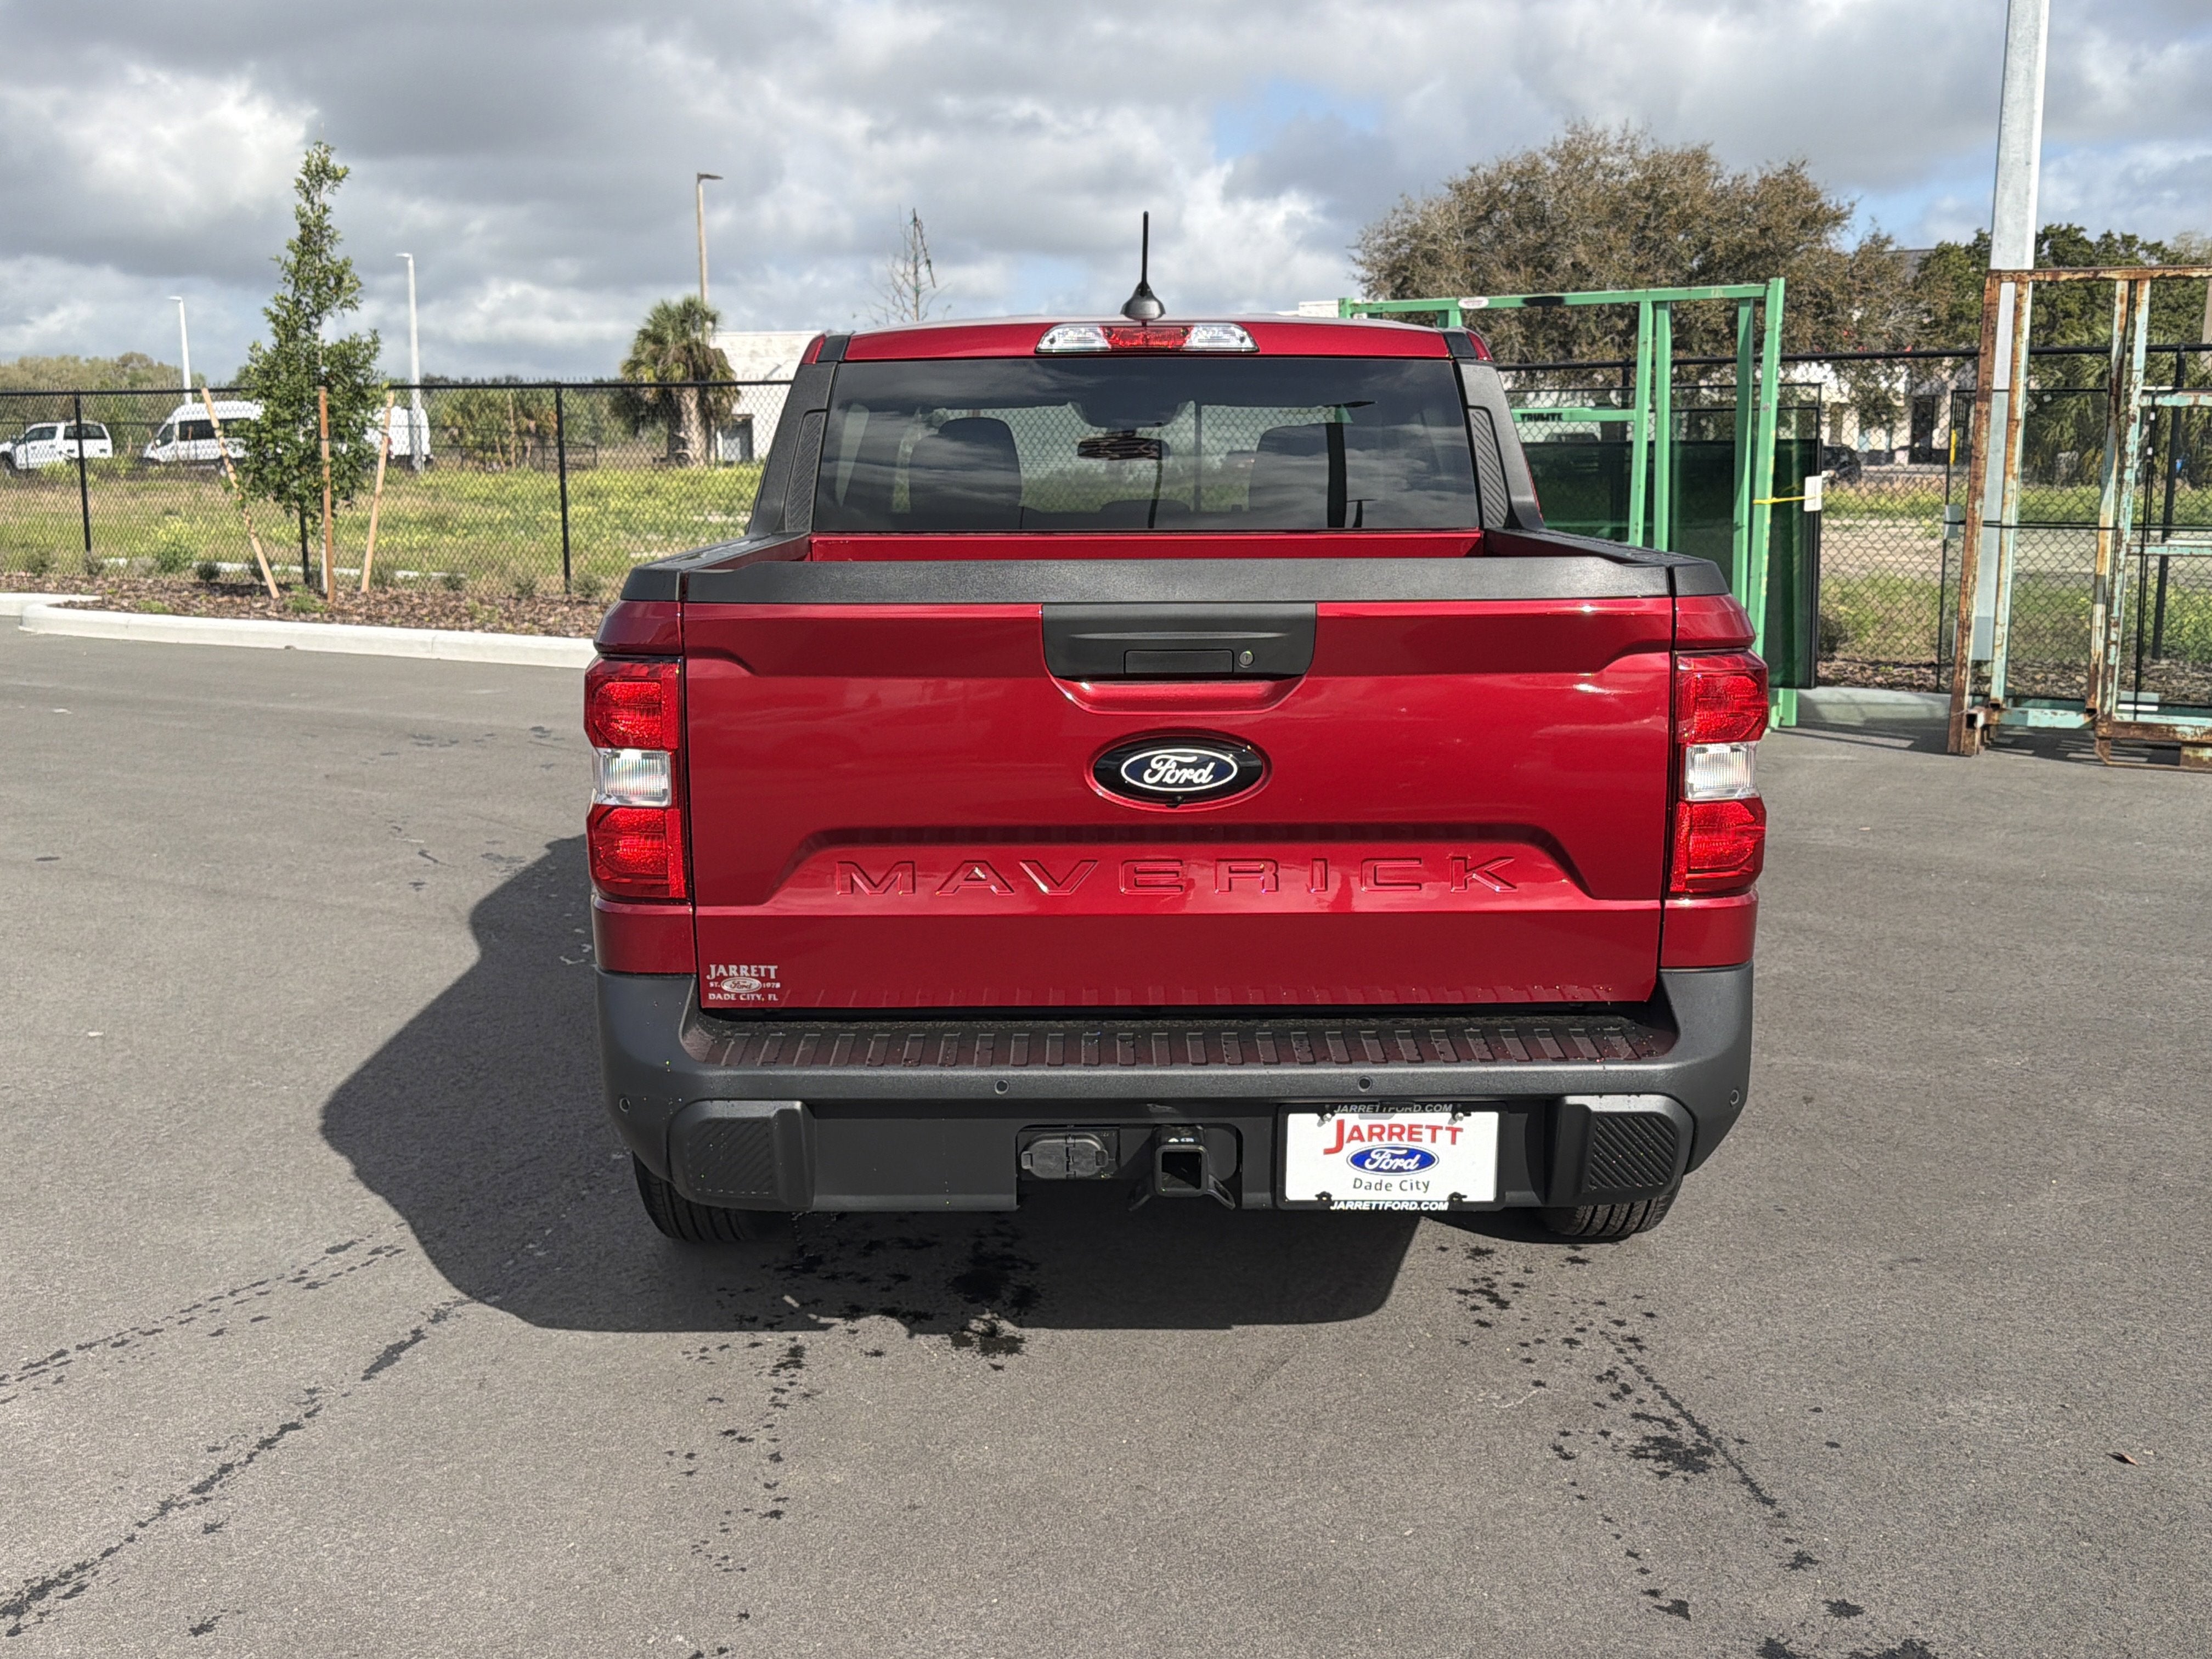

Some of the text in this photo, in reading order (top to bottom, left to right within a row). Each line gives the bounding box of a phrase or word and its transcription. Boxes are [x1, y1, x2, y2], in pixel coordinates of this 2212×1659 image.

[1143, 754, 1215, 785] Ford
[836, 857, 1519, 895] MAVERICK
[706, 964, 778, 980] JARRETT
[1323, 1119, 1464, 1155] JARRETT
[1364, 1149, 1421, 1170] Ford
[1353, 1178, 1430, 1193] Dade City
[1330, 1200, 1449, 1211] JARRETTFORD.COM
